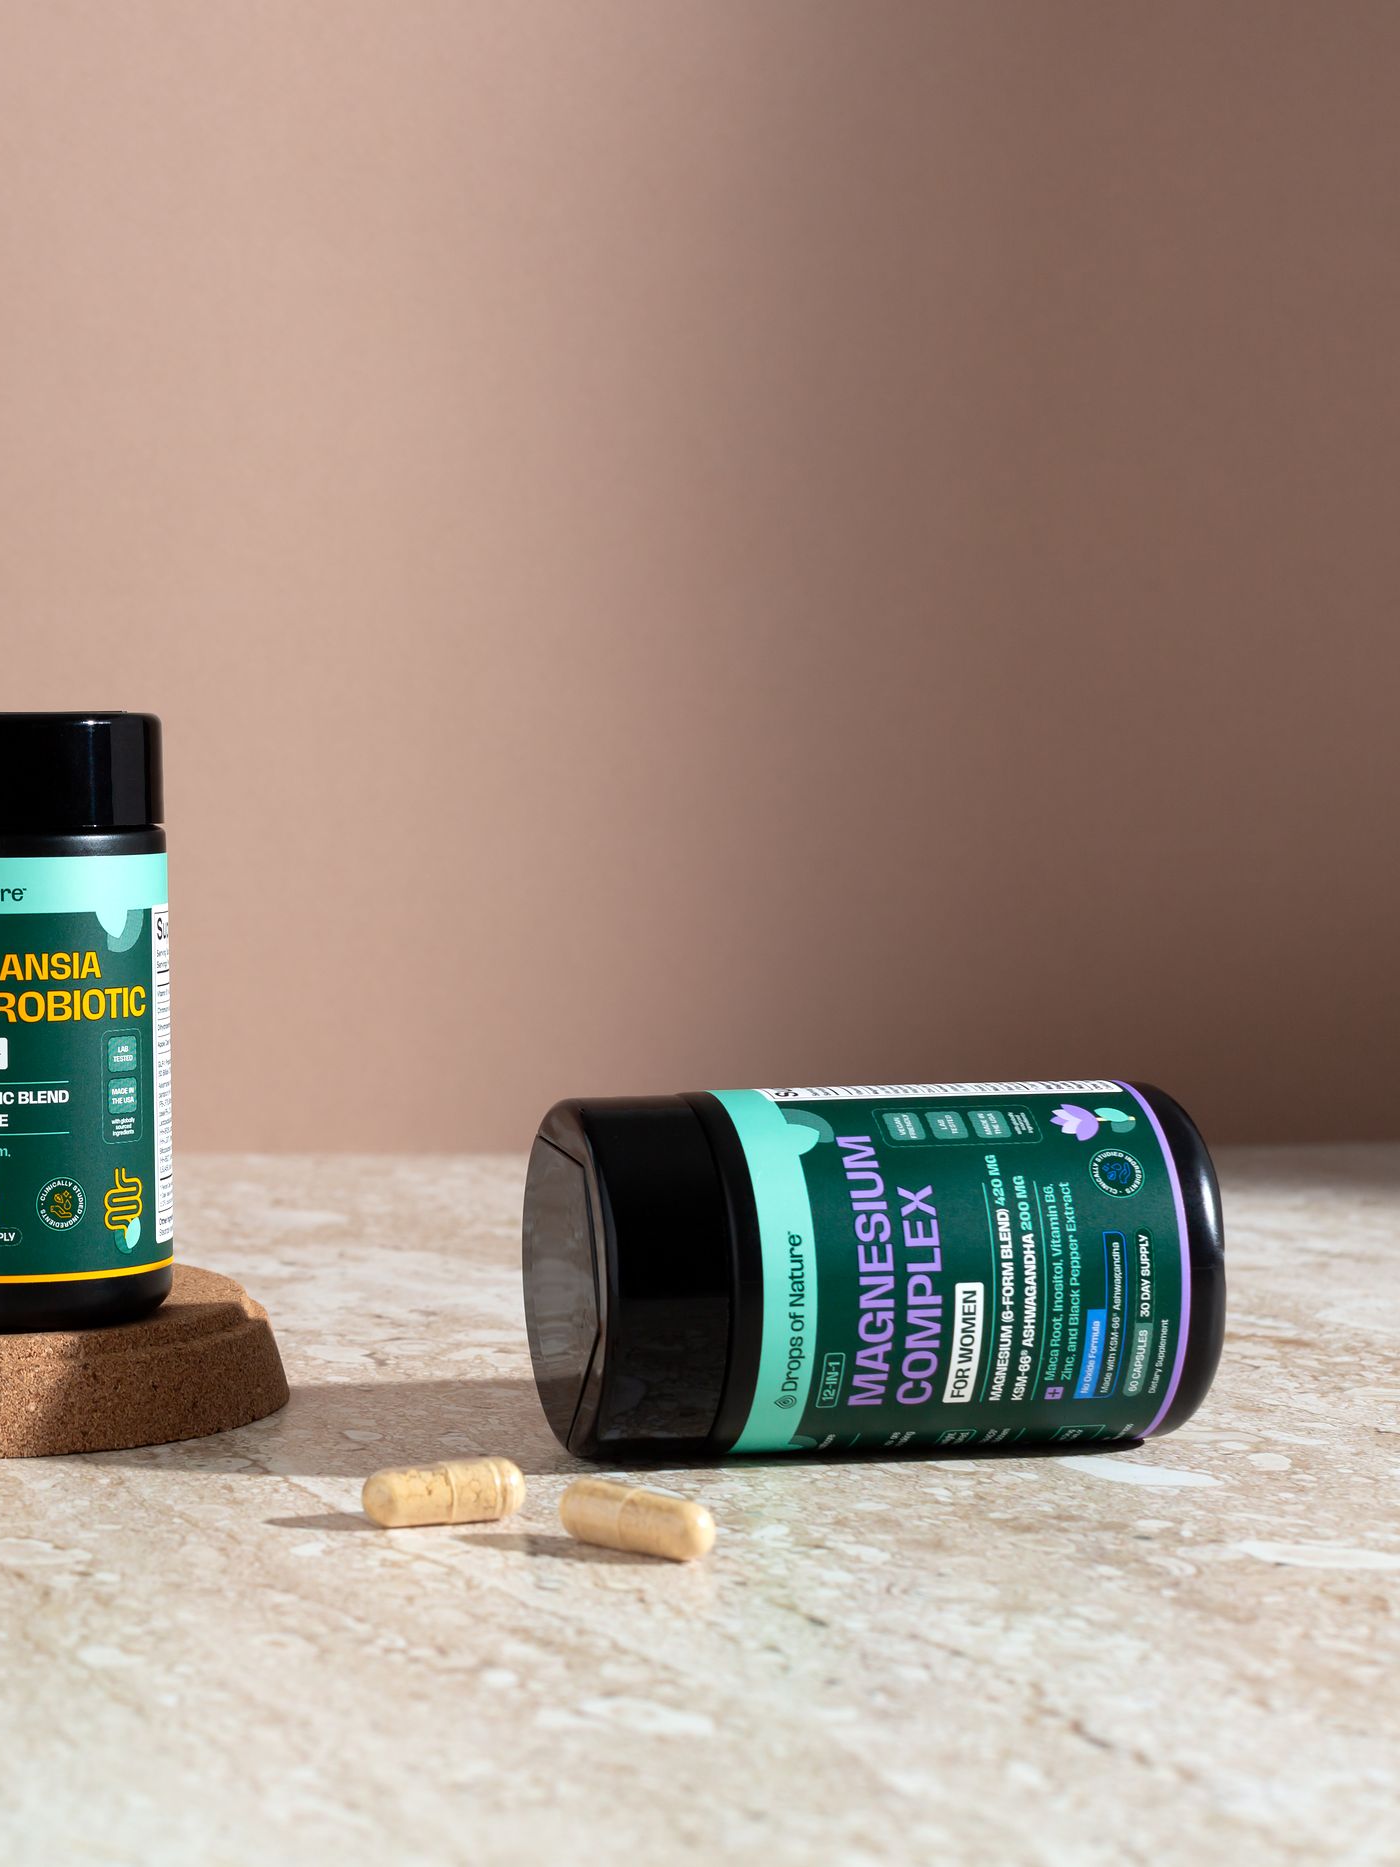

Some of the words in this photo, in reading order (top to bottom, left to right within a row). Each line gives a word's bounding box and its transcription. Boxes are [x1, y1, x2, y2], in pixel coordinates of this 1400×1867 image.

[113, 1054, 134, 1062] TESTED
[18, 1090, 69, 1105] BLEND
[112, 1088, 128, 1096] MADE
[124, 1096, 134, 1104] USA
[893, 1116, 906, 1135] VEGAN
[902, 1114, 917, 1138] FRIENDLY
[937, 1119, 948, 1129] LAB
[945, 1114, 959, 1134] TESTED
[986, 1112, 996, 1122] USA
[991, 1123, 1002, 1134] THE
[984, 1154, 1000, 1175] MG
[1092, 1161, 1117, 1194] CLINICALLY
[1124, 1155, 1141, 1194] INGREDIENTS
[40, 1180, 72, 1202] CLINICALLY
[72, 1185, 84, 1214] STUDIED
[990, 1178, 1006, 1205] 420
[1012, 1175, 1027, 1198] MG
[40, 1208, 79, 1228] INGREDIENTS
[1016, 1201, 1032, 1230] 200
[1059, 1181, 1076, 1231] Extract
[995, 1208, 1013, 1258] BLEND)
[1046, 1204, 1062, 1256] Vitamin
[1066, 1234, 1082, 1285] Pepper
[1138, 1234, 1150, 1276] SUPPLY
[835, 1135, 895, 1405] MAGNESIUM
[1110, 1241, 1122, 1310] Ashwagandha
[896, 1184, 942, 1404] COMPLEX
[999, 1261, 1014, 1322] (6-FORM
[1021, 1232, 1037, 1347] ASHWAGANDHA
[1140, 1278, 1151, 1300] DAY
[1067, 1288, 1080, 1325] Black
[1139, 1302, 1149, 1316] 30
[787, 1312, 804, 1331] of
[957, 1290, 976, 1362] WOMEN
[1065, 1327, 1078, 1351] and
[1088, 1320, 1100, 1358] Formula
[1154, 1318, 1169, 1367] Supplement
[781, 1336, 805, 1391] Drops
[988, 1325, 1012, 1400] MAGNESIUM
[1044, 1348, 1059, 1380] Maca
[1105, 1352, 1116, 1371] with
[1130, 1329, 1148, 1379] CAPSULES
[821, 1360, 840, 1400] 12-IN-1
[950, 1367, 970, 1398] FOR
[1083, 1359, 1096, 1381] Oxide
[1099, 1372, 1112, 1393] Made
[1147, 1368, 1162, 1393] Dietary
[1080, 1382, 1090, 1393] No
[1127, 1380, 1138, 1391] 60
